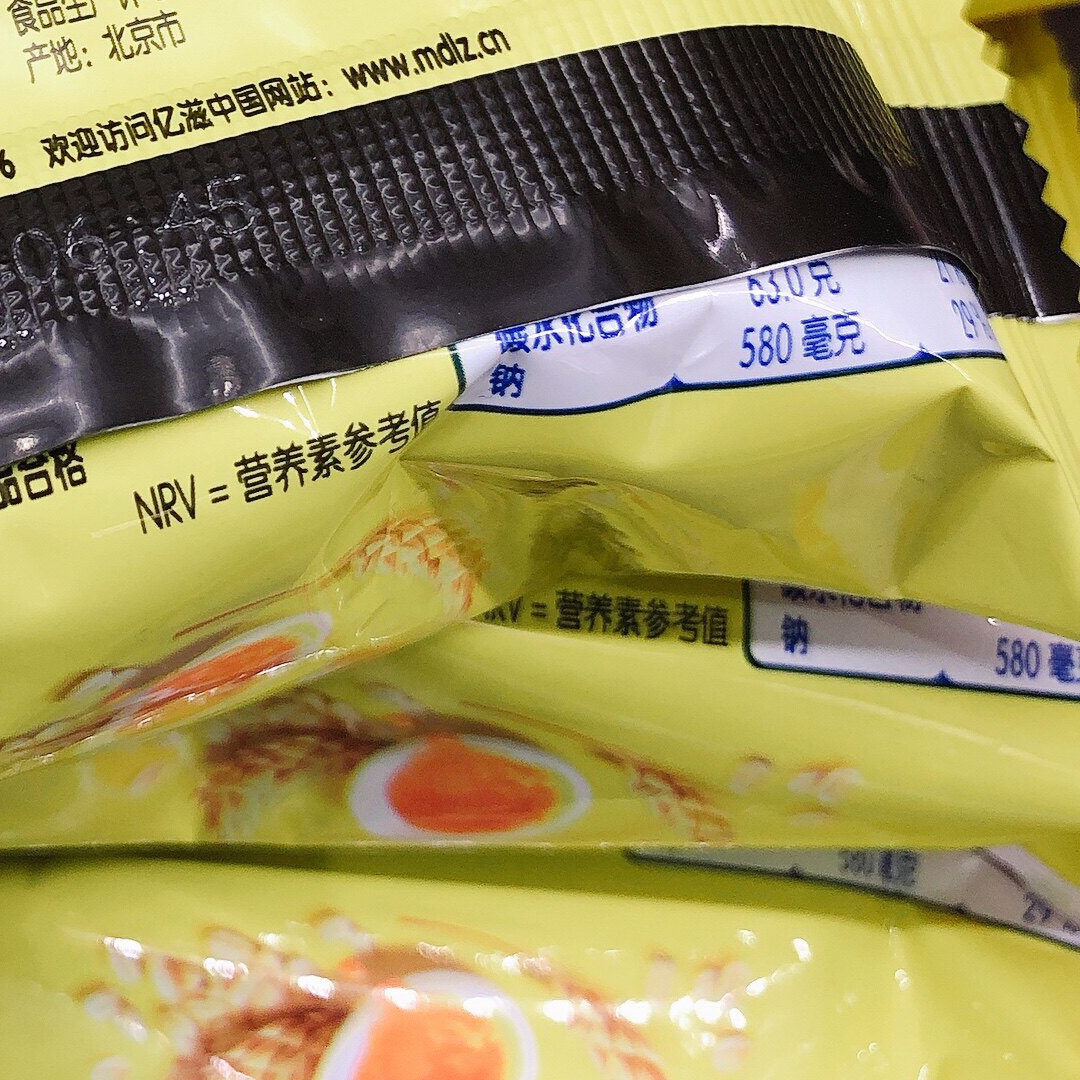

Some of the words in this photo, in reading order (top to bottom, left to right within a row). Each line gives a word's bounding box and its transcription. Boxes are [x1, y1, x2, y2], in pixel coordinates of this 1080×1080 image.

[102, 10, 187, 63] 北京市
[341, 23, 512, 90] www.mdlz.cn
[738, 322, 793, 370] 580
[801, 310, 866, 362] 毫克
[489, 363, 526, 399] 钠
[133, 475, 198, 534] NRV
[234, 400, 443, 504] 营养素参考值
[555, 589, 730, 648] 营养素参考值
[995, 636, 1040, 678] 580
